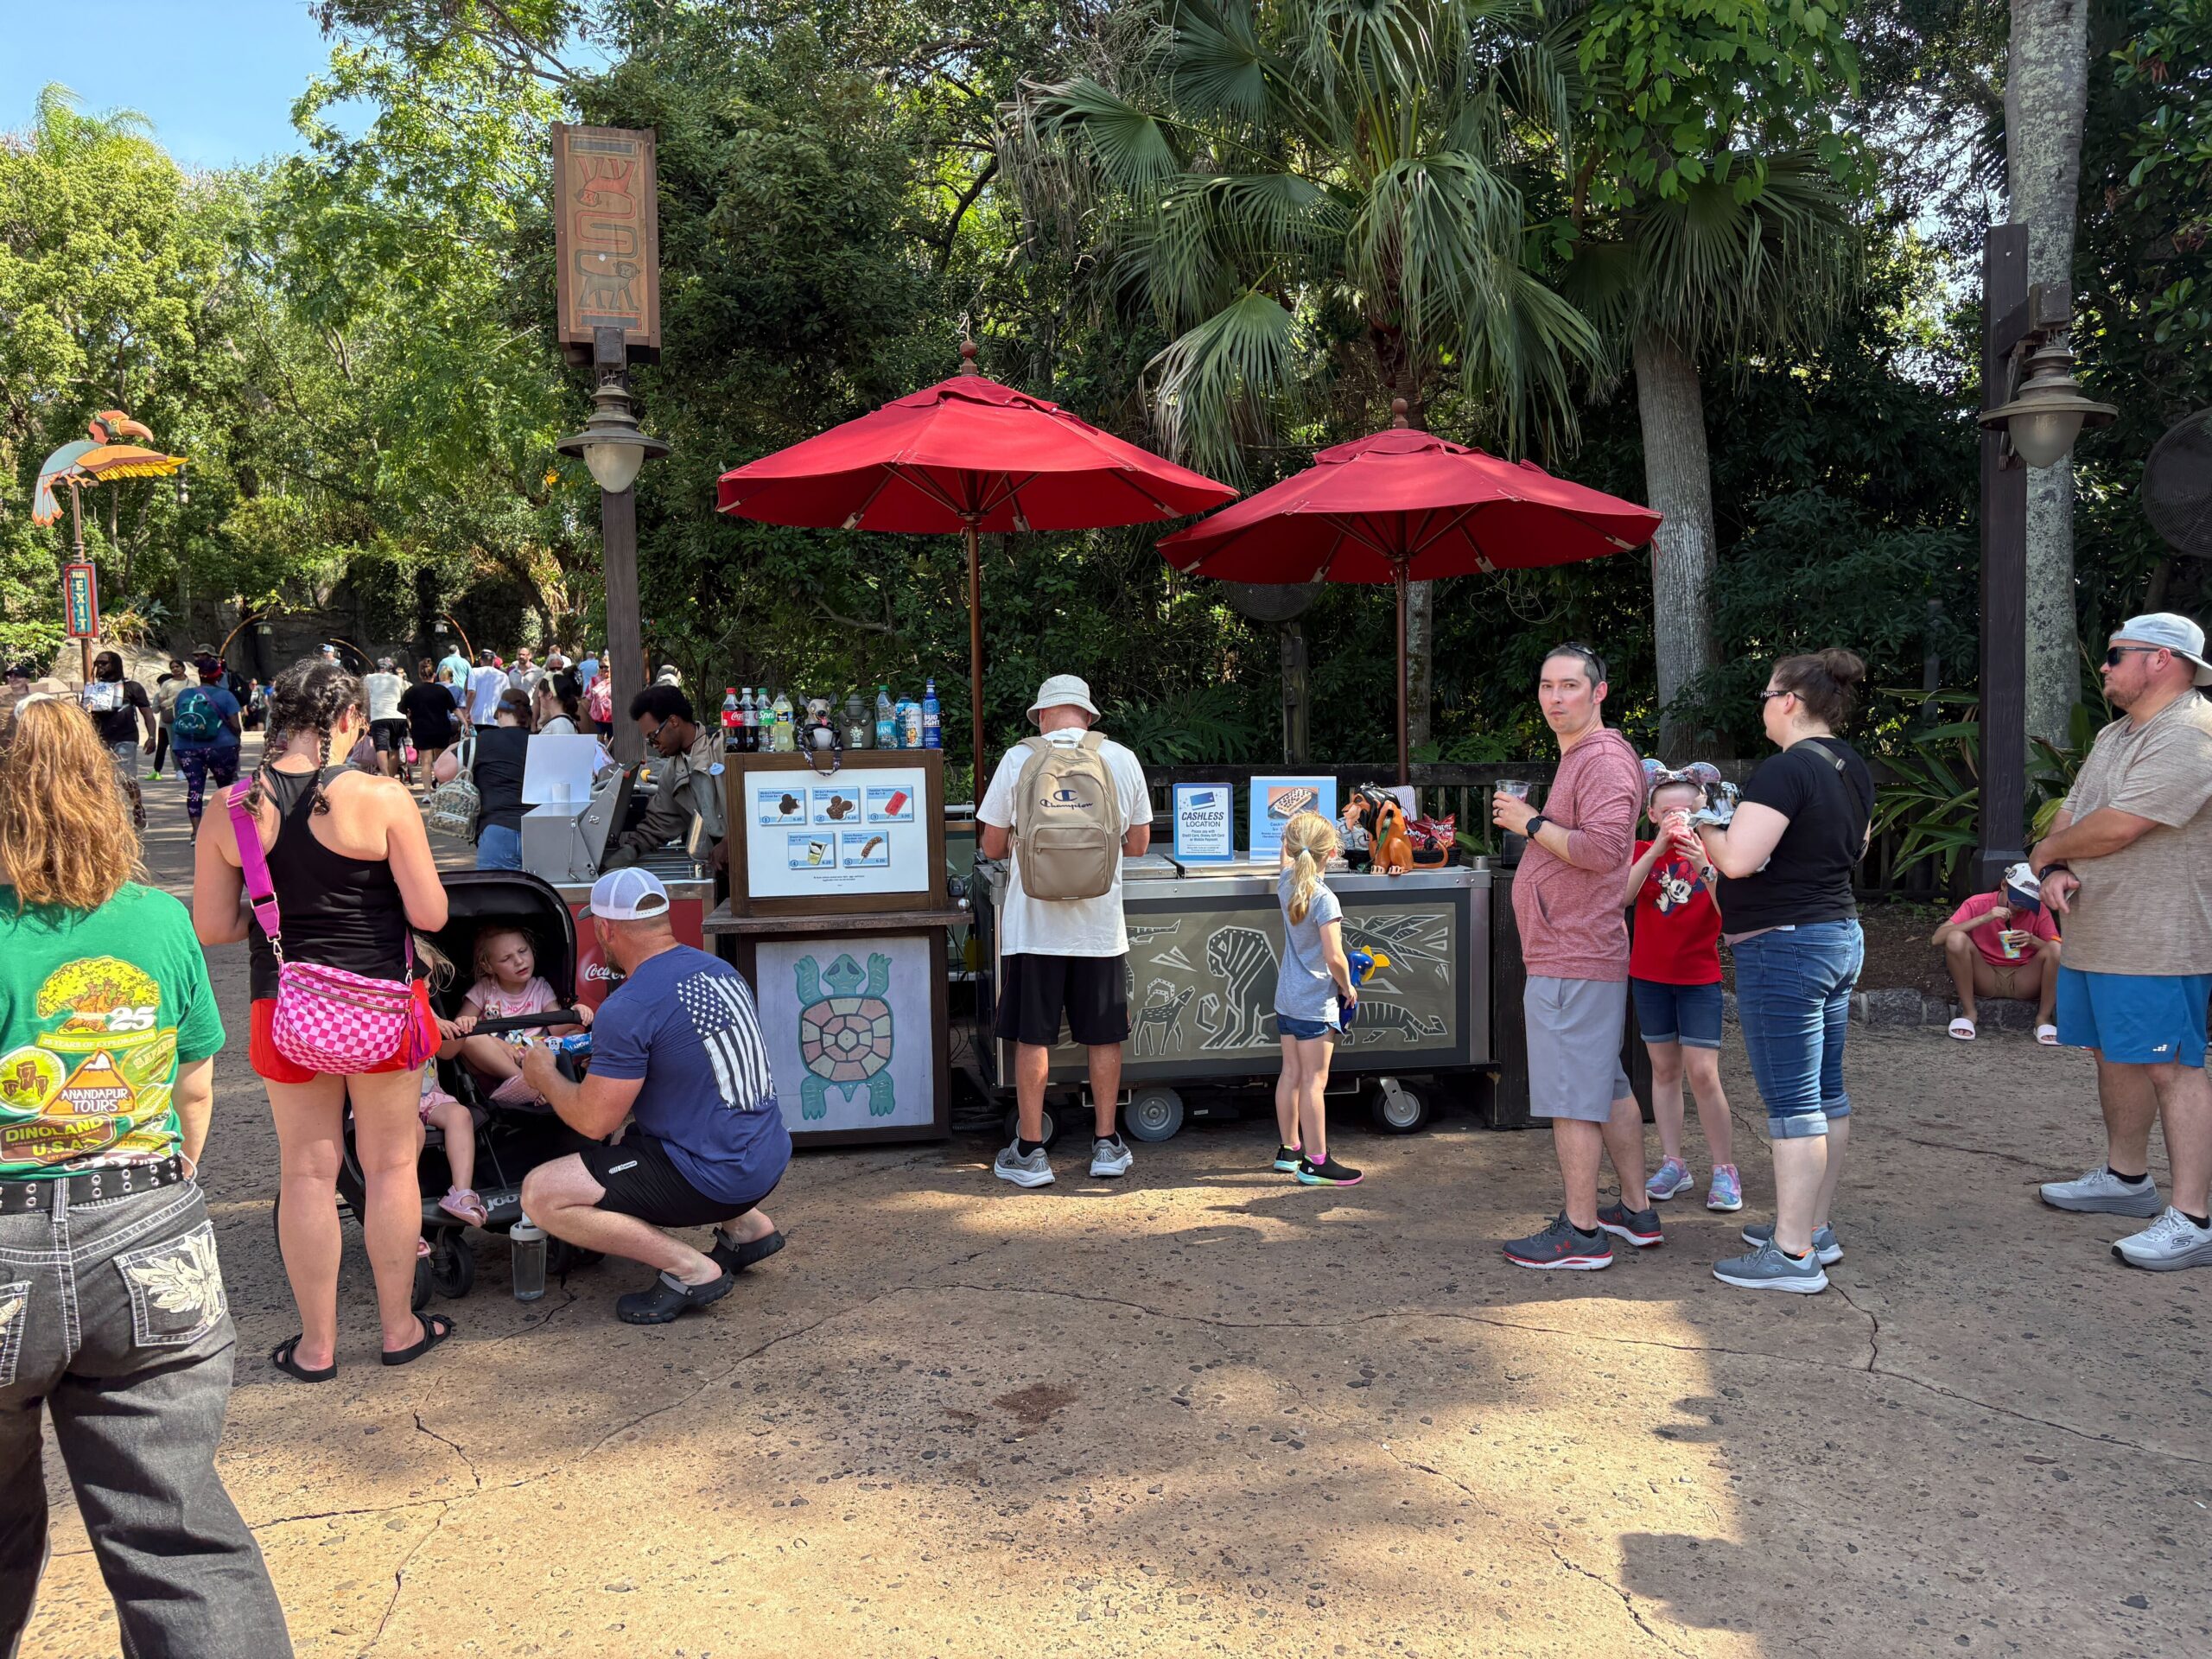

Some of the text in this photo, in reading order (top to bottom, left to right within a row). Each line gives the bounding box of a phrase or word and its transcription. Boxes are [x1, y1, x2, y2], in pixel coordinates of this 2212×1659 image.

[75, 580, 86, 630] EXIT
[1039, 798, 1094, 810] Champion
[1181, 812, 1224, 821] CASHLESS
[109, 1006, 156, 1031] 25
[54, 1039, 79, 1048] YEARS
[83, 1039, 96, 1048] OF
[97, 1032, 155, 1047] EXPLORATION
[61, 1089, 129, 1100] ANANDAPUR
[73, 1099, 118, 1113] TOURS
[5, 1117, 104, 1142] DINOLAND
[32, 1140, 88, 1156] U.S.A.
